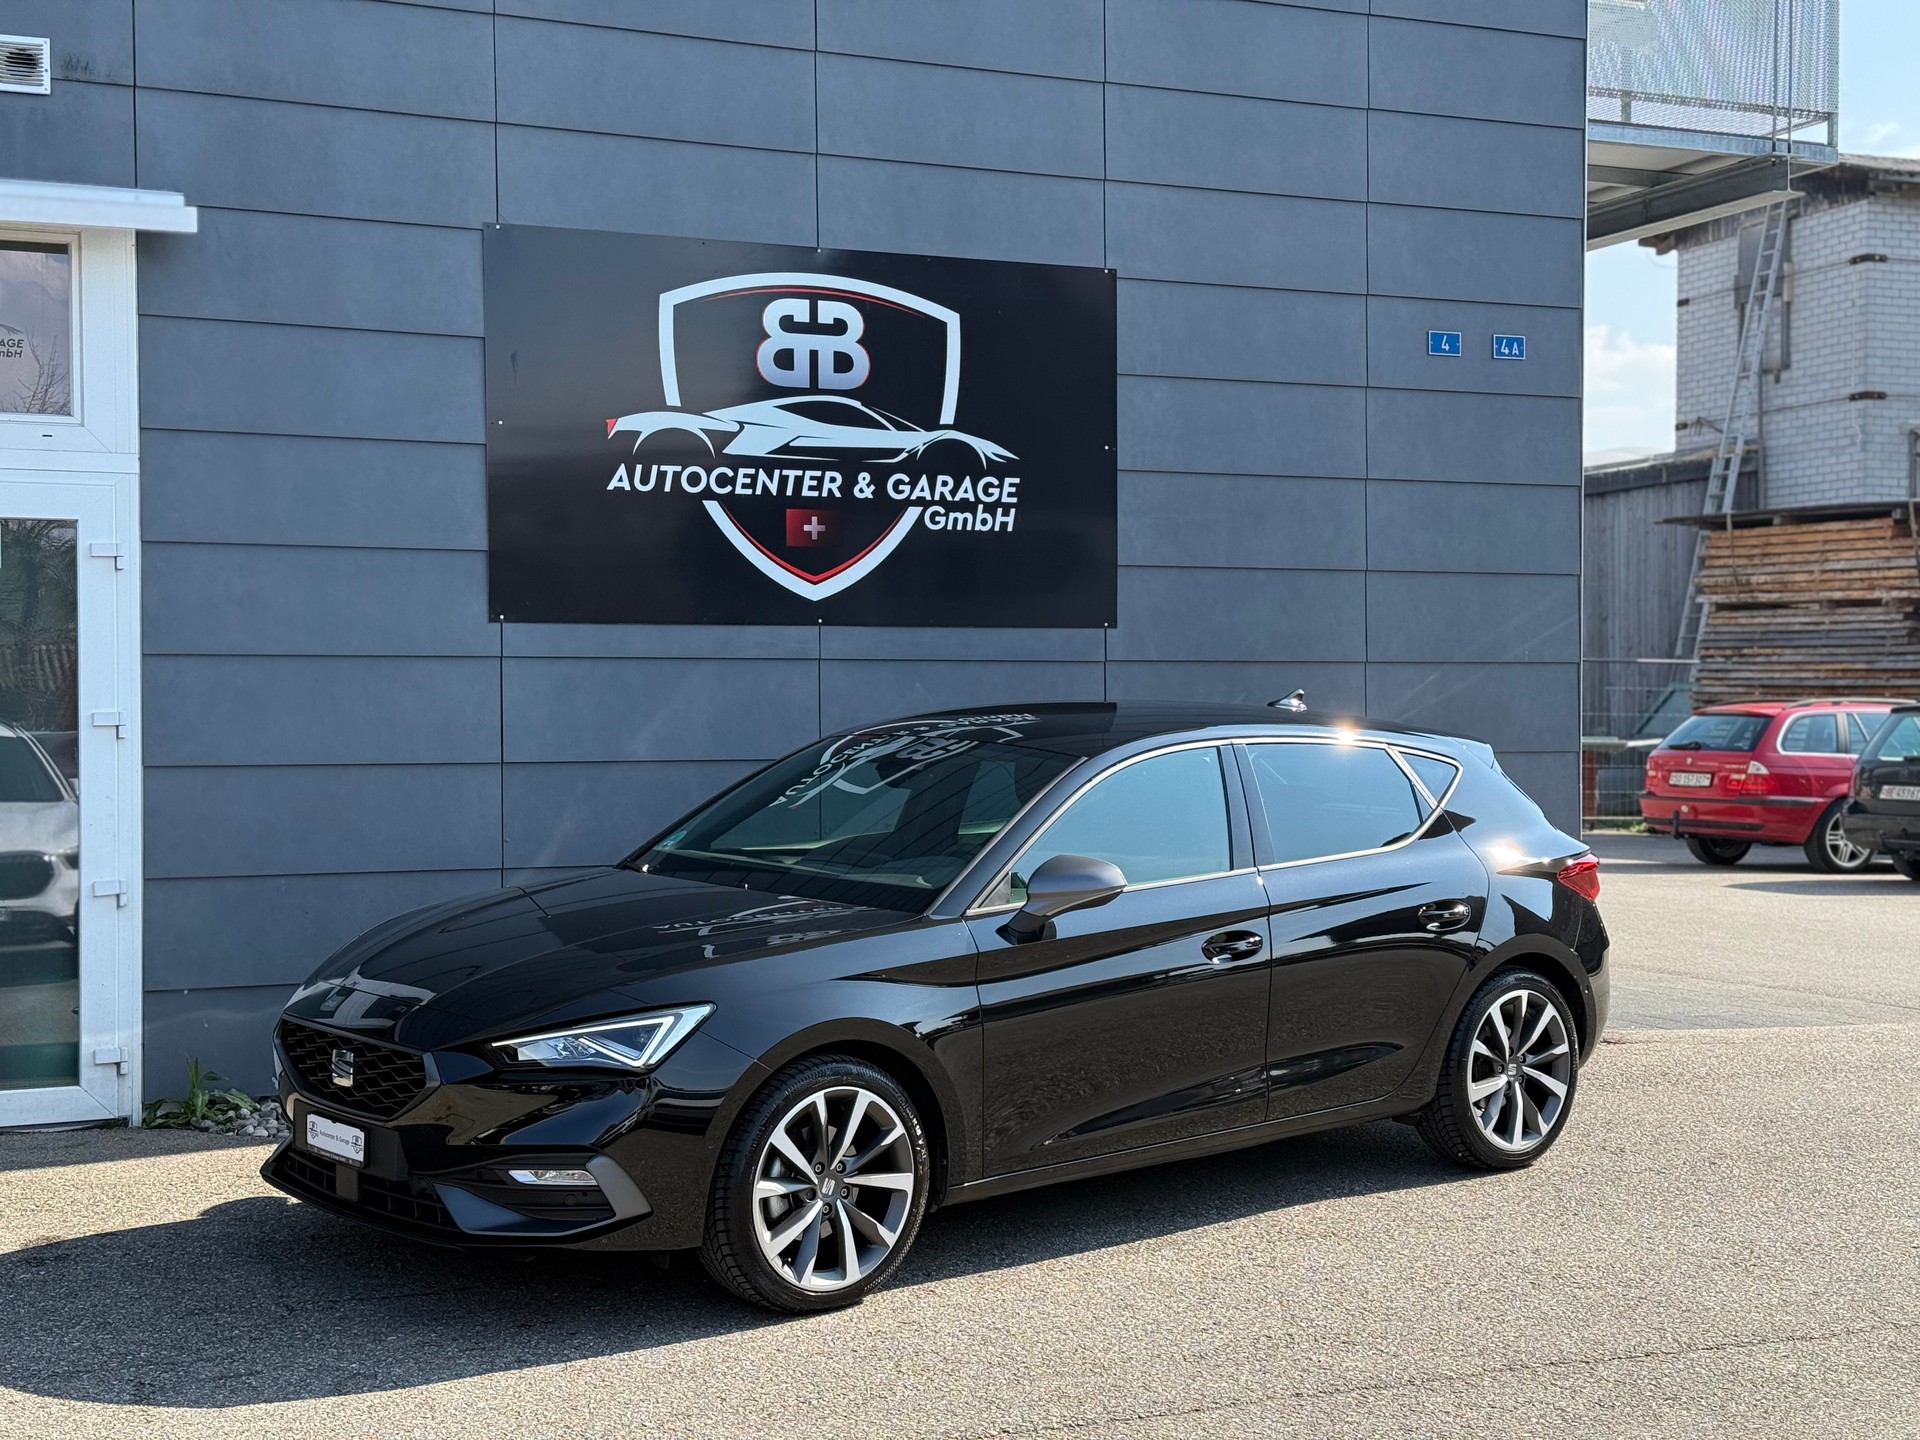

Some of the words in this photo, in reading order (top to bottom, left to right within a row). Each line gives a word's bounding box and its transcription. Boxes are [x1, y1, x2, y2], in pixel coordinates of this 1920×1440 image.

[1441, 335, 1449, 351] 4
[606, 463, 843, 498] AUTOCENTER
[853, 472, 876, 499] &
[886, 473, 1020, 503] GARAGE
[924, 504, 1016, 532] GmbH
